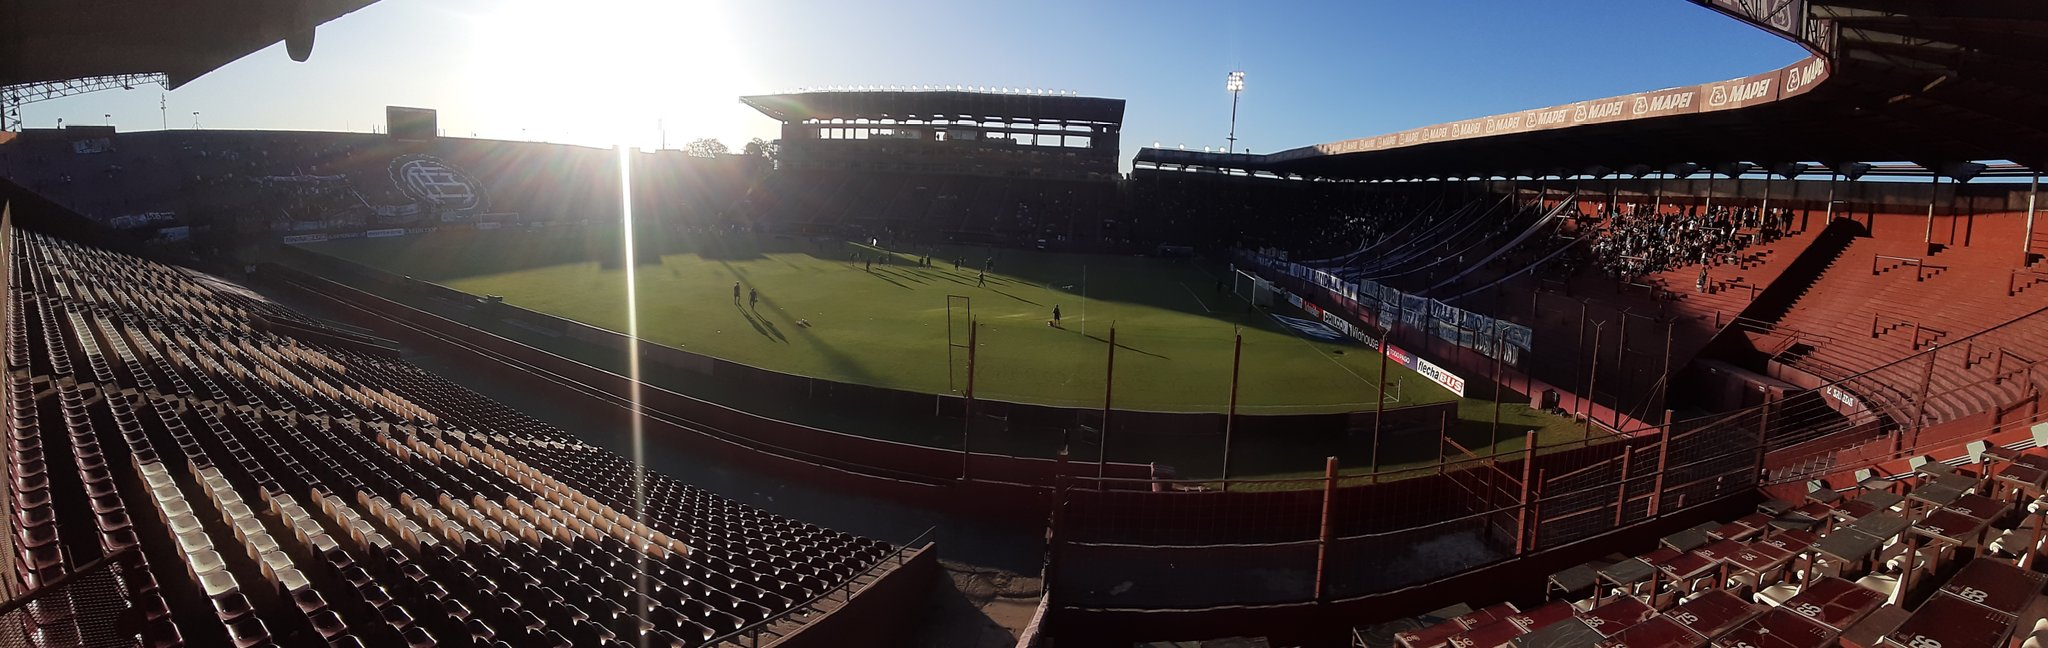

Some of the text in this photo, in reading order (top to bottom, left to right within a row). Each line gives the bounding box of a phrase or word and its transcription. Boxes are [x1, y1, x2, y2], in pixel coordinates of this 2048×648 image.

[1729, 79, 1770, 102] MAPEI
[1588, 101, 1624, 119] MAPEI
[1650, 92, 1692, 112] MAPEI
[1495, 116, 1520, 132] MAPEI
[1538, 109, 1567, 125] MAPEI
[1430, 128, 1447, 138] MAPEI
[1460, 122, 1481, 135] MAPEI
[1324, 312, 1343, 330] PHILCO
[1440, 371, 1462, 392] BUS
[1832, 388, 1854, 407] SALIDA
[1960, 586, 1989, 603] 55
[1796, 602, 1822, 617] 65
[1585, 615, 1605, 628] 85
[1676, 611, 1699, 626] 75
